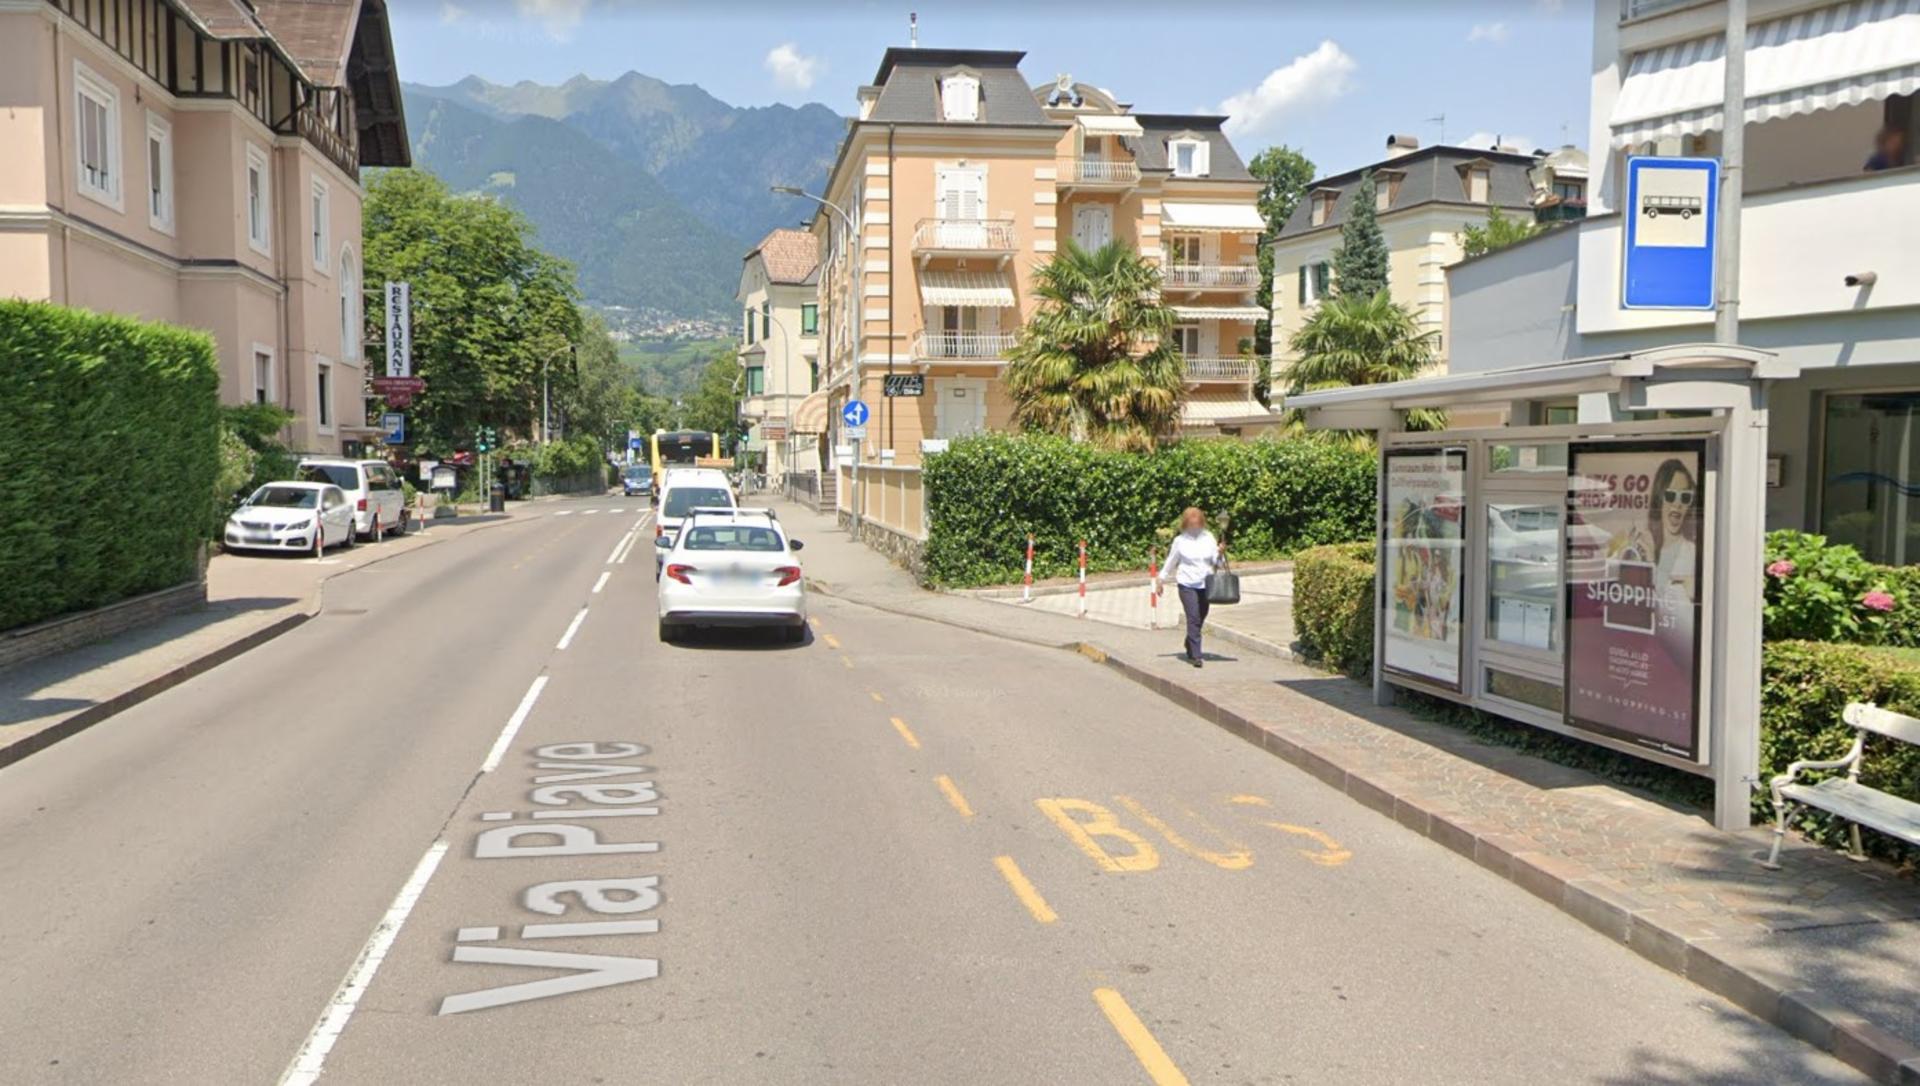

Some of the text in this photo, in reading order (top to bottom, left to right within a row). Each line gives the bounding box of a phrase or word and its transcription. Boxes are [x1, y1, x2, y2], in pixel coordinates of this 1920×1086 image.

[391, 286, 404, 376] RESTAURANT
[1623, 474, 1650, 493] GO
[1036, 795, 1352, 872] BUS
